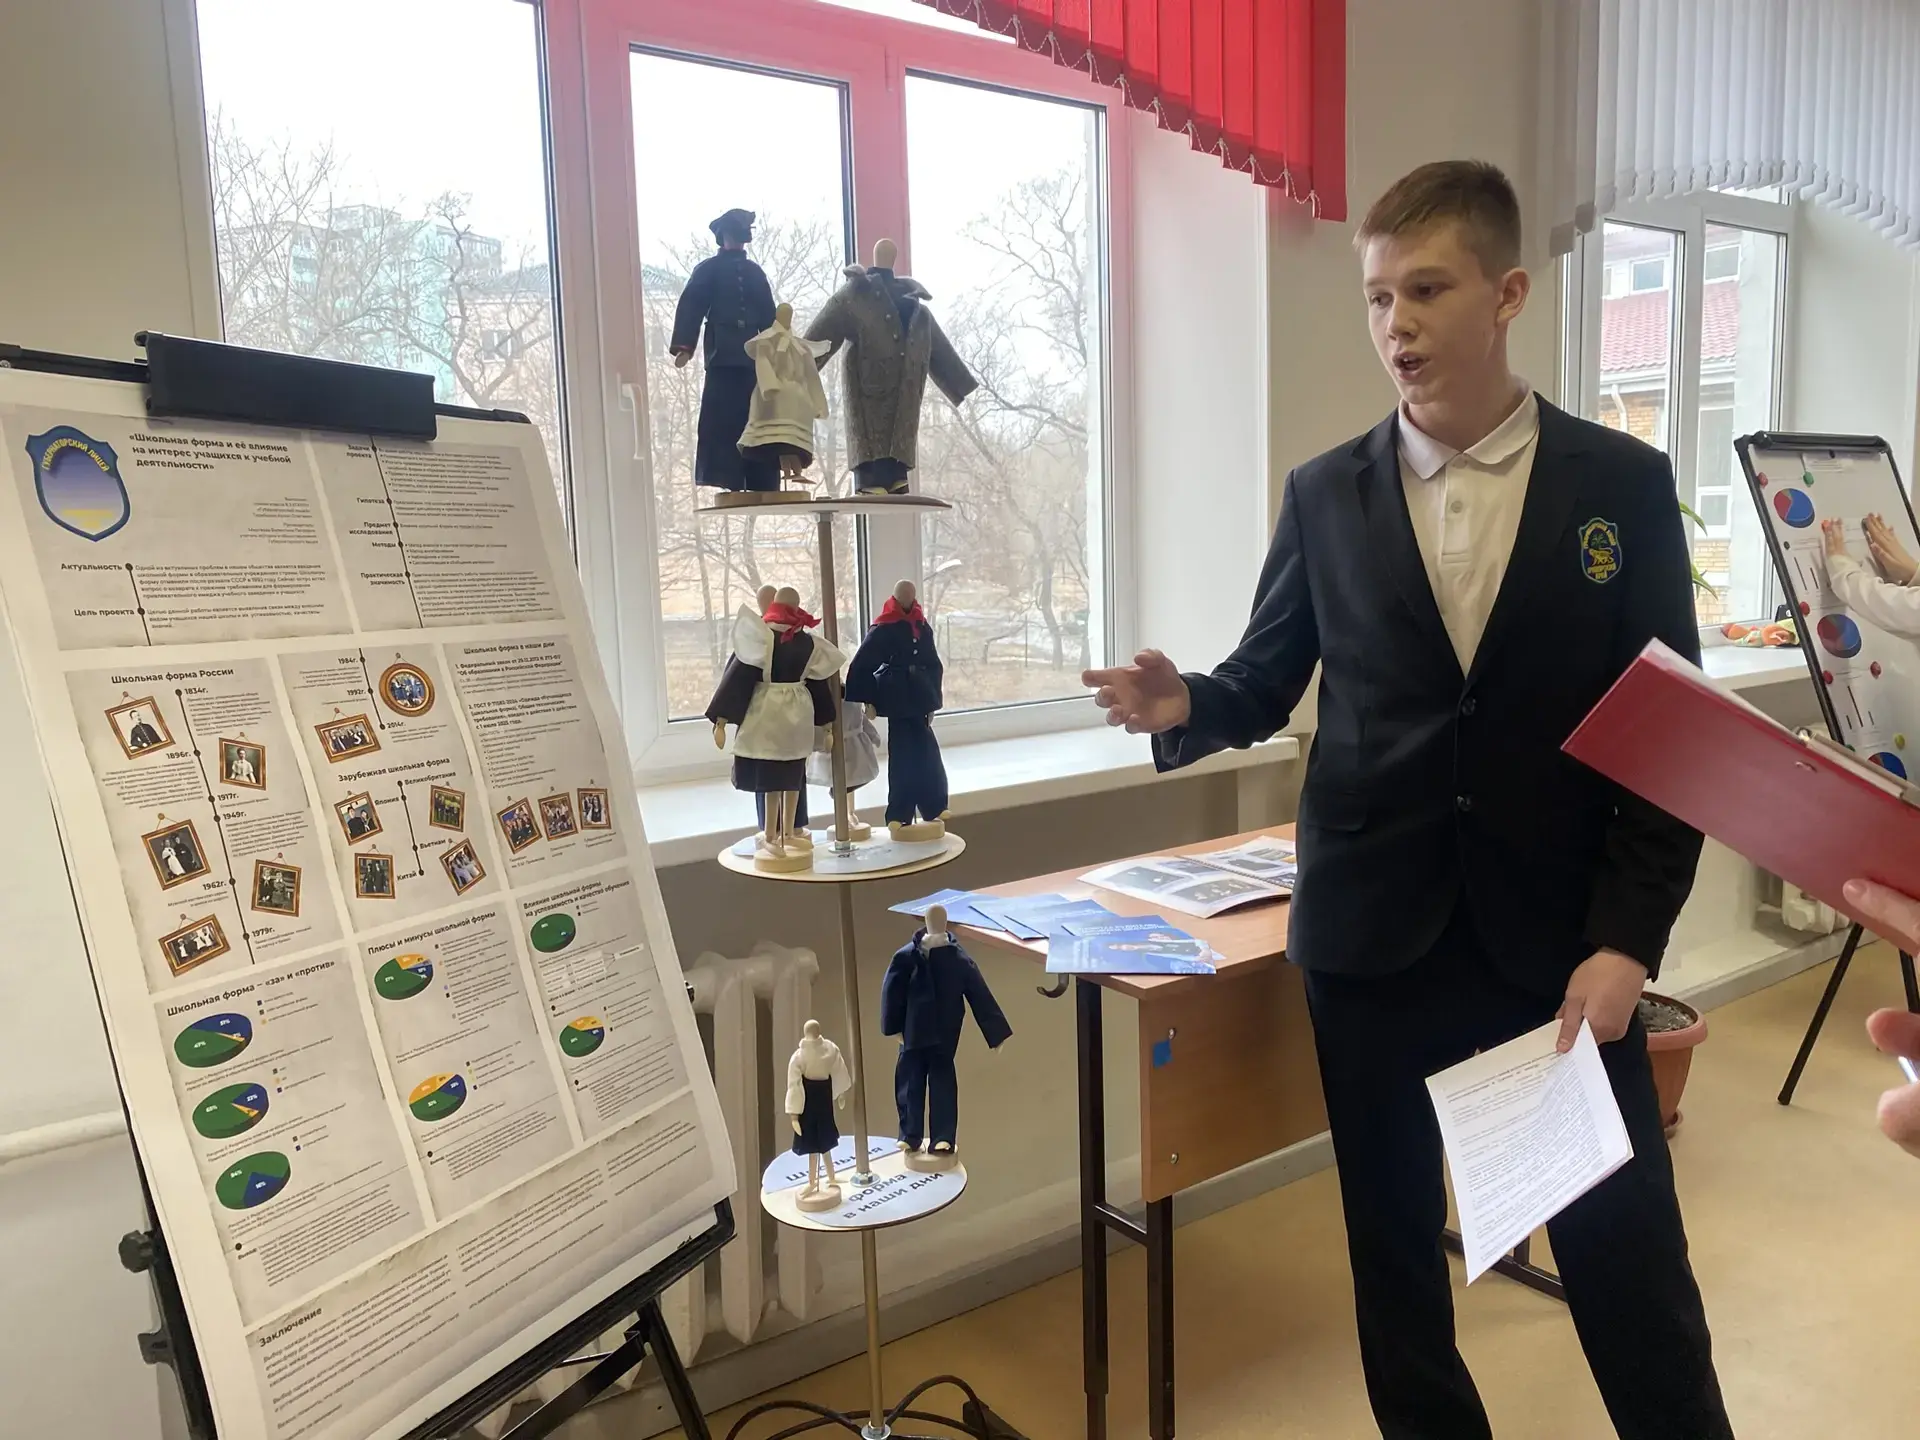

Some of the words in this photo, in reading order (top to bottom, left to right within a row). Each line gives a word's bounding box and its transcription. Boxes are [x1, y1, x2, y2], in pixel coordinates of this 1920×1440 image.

[129, 433, 189, 446] «Школьная
[191, 438, 224, 450] форма
[235, 442, 247, 450] её
[248, 443, 288, 452] влияние
[132, 446, 146, 454] на
[148, 447, 191, 457] интерес
[193, 450, 242, 461] учащихся
[251, 453, 292, 464] учебной
[136, 458, 215, 470] деятельности»
[60, 562, 123, 572] Актуальность
[74, 608, 98, 618] Цель
[99, 607, 135, 619] проекта
[464, 646, 498, 655] Школьная
[498, 644, 520, 653] форма
[338, 657, 359, 665] 1984г.
[111, 674, 163, 685] Школьная
[165, 671, 198, 682] форма
[199, 668, 234, 679] России
[184, 687, 209, 695] 1834г.
[387, 721, 407, 730] 2014г.
[166, 751, 192, 761] 1896г.
[338, 767, 387, 782] Зарубежная
[388, 763, 425, 774] школьная
[426, 758, 451, 768] форма
[405, 771, 456, 785] Великобритания
[217, 793, 240, 802] 1917г.
[375, 796, 399, 806] Япония
[223, 811, 248, 820] 1949г.
[420, 839, 446, 850] Вьетнам
[397, 871, 417, 881] Китай
[202, 881, 228, 891] 1962г.
[551, 886, 580, 902] школьной
[581, 880, 602, 893] формы
[525, 908, 534, 917] на
[534, 897, 574, 917] успеваемость
[579, 888, 604, 901] качество
[605, 880, 630, 893] обучения
[251, 927, 275, 938] 1979г.
[367, 941, 396, 955] Плюсы
[404, 930, 433, 943] минусы
[435, 918, 471, 935] школьной
[472, 911, 496, 924] формы
[167, 994, 221, 1017] Школьная
[223, 984, 255, 1001] форма
[265, 975, 285, 987] «за»
[287, 972, 293, 980] и
[295, 961, 335, 977] «против»
[848, 1173, 908, 1203] форма
[843, 1210, 857, 1220] в
[858, 1187, 909, 1213] наши
[910, 1172, 945, 1191] дни
[260, 1307, 322, 1348] Заключение
